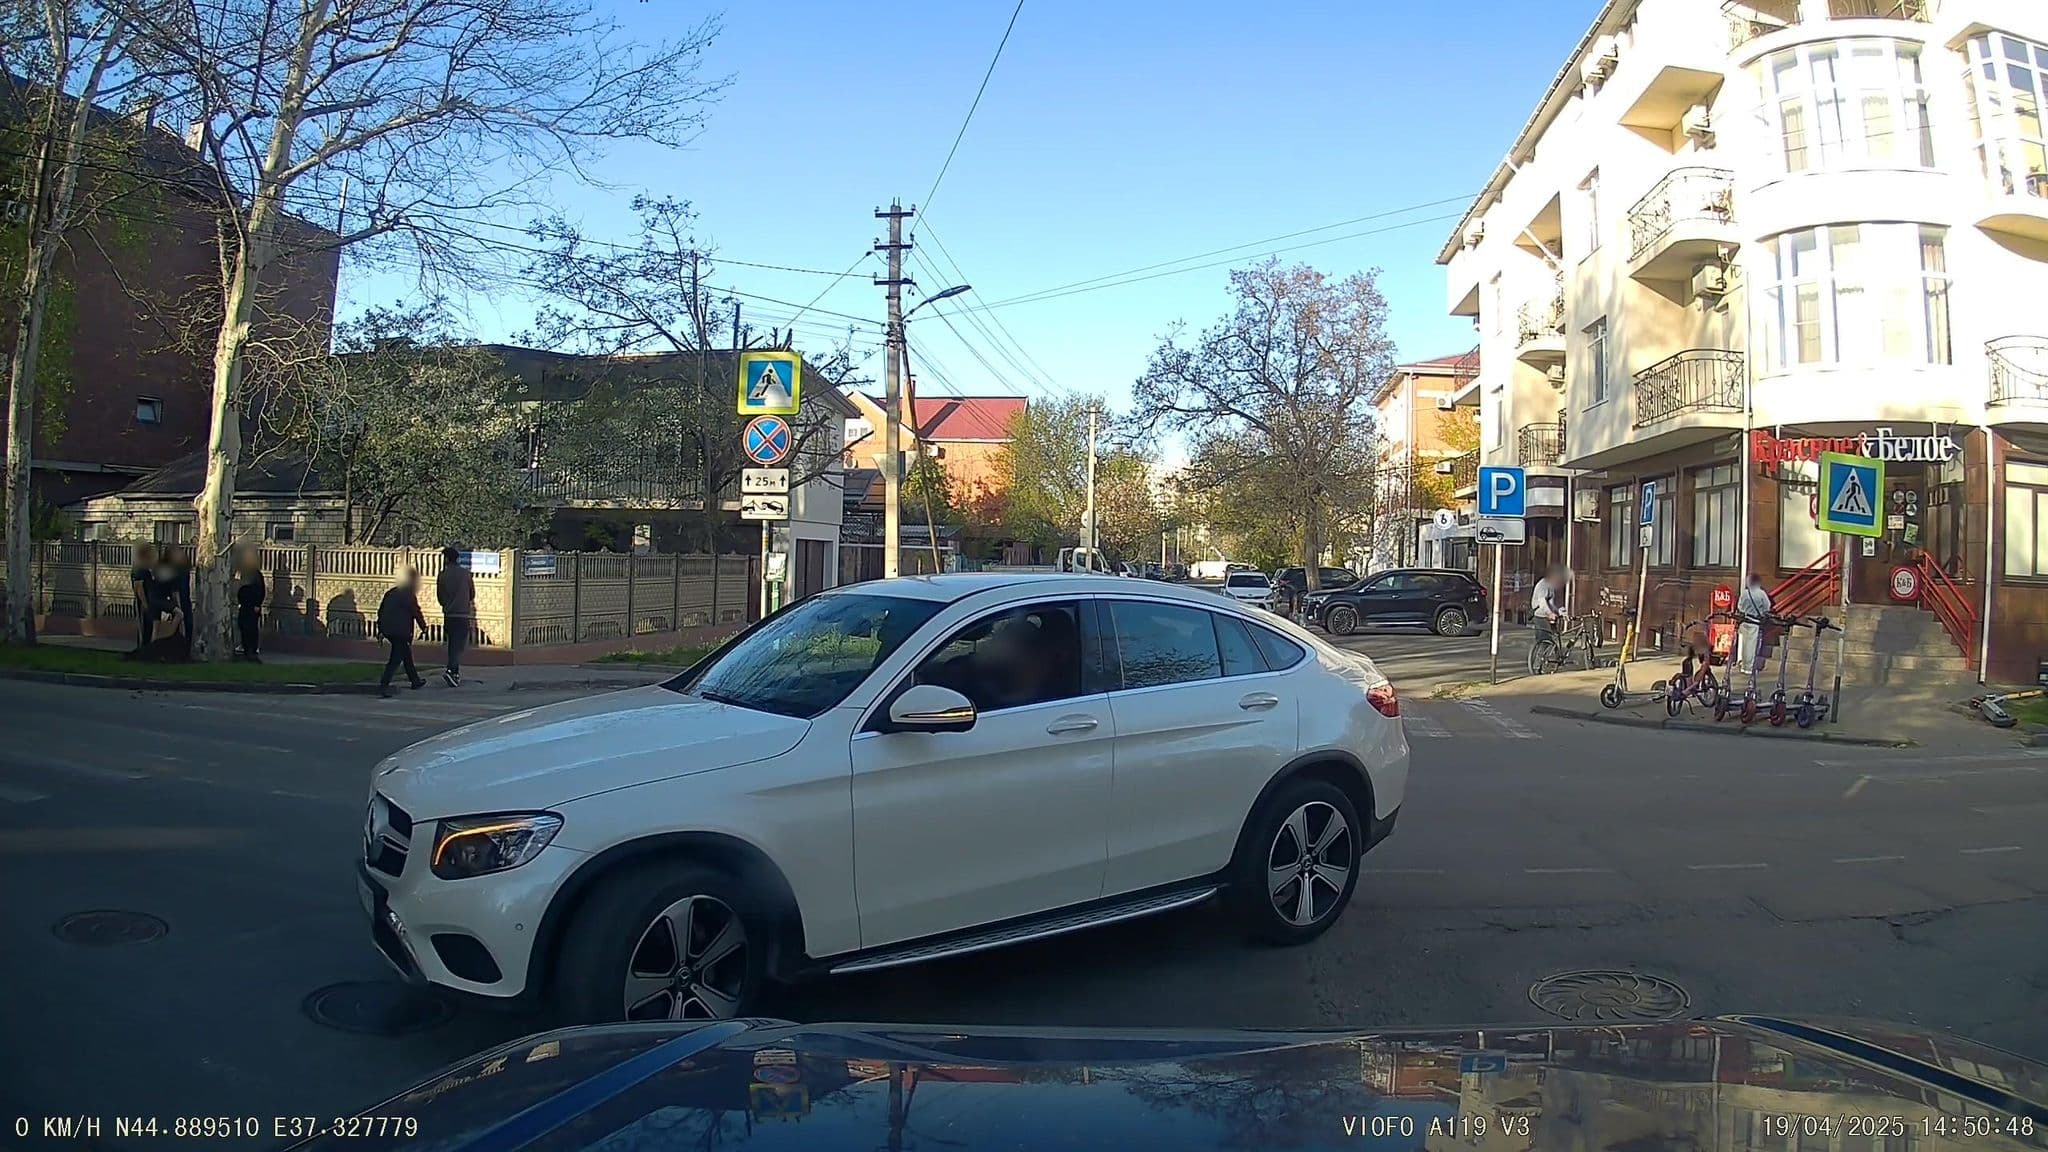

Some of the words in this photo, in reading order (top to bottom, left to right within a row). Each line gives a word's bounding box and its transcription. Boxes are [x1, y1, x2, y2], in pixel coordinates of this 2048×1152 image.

[1876, 427, 1953, 461] Белое
[1491, 472, 1516, 510] P
[1643, 488, 1653, 520] P
